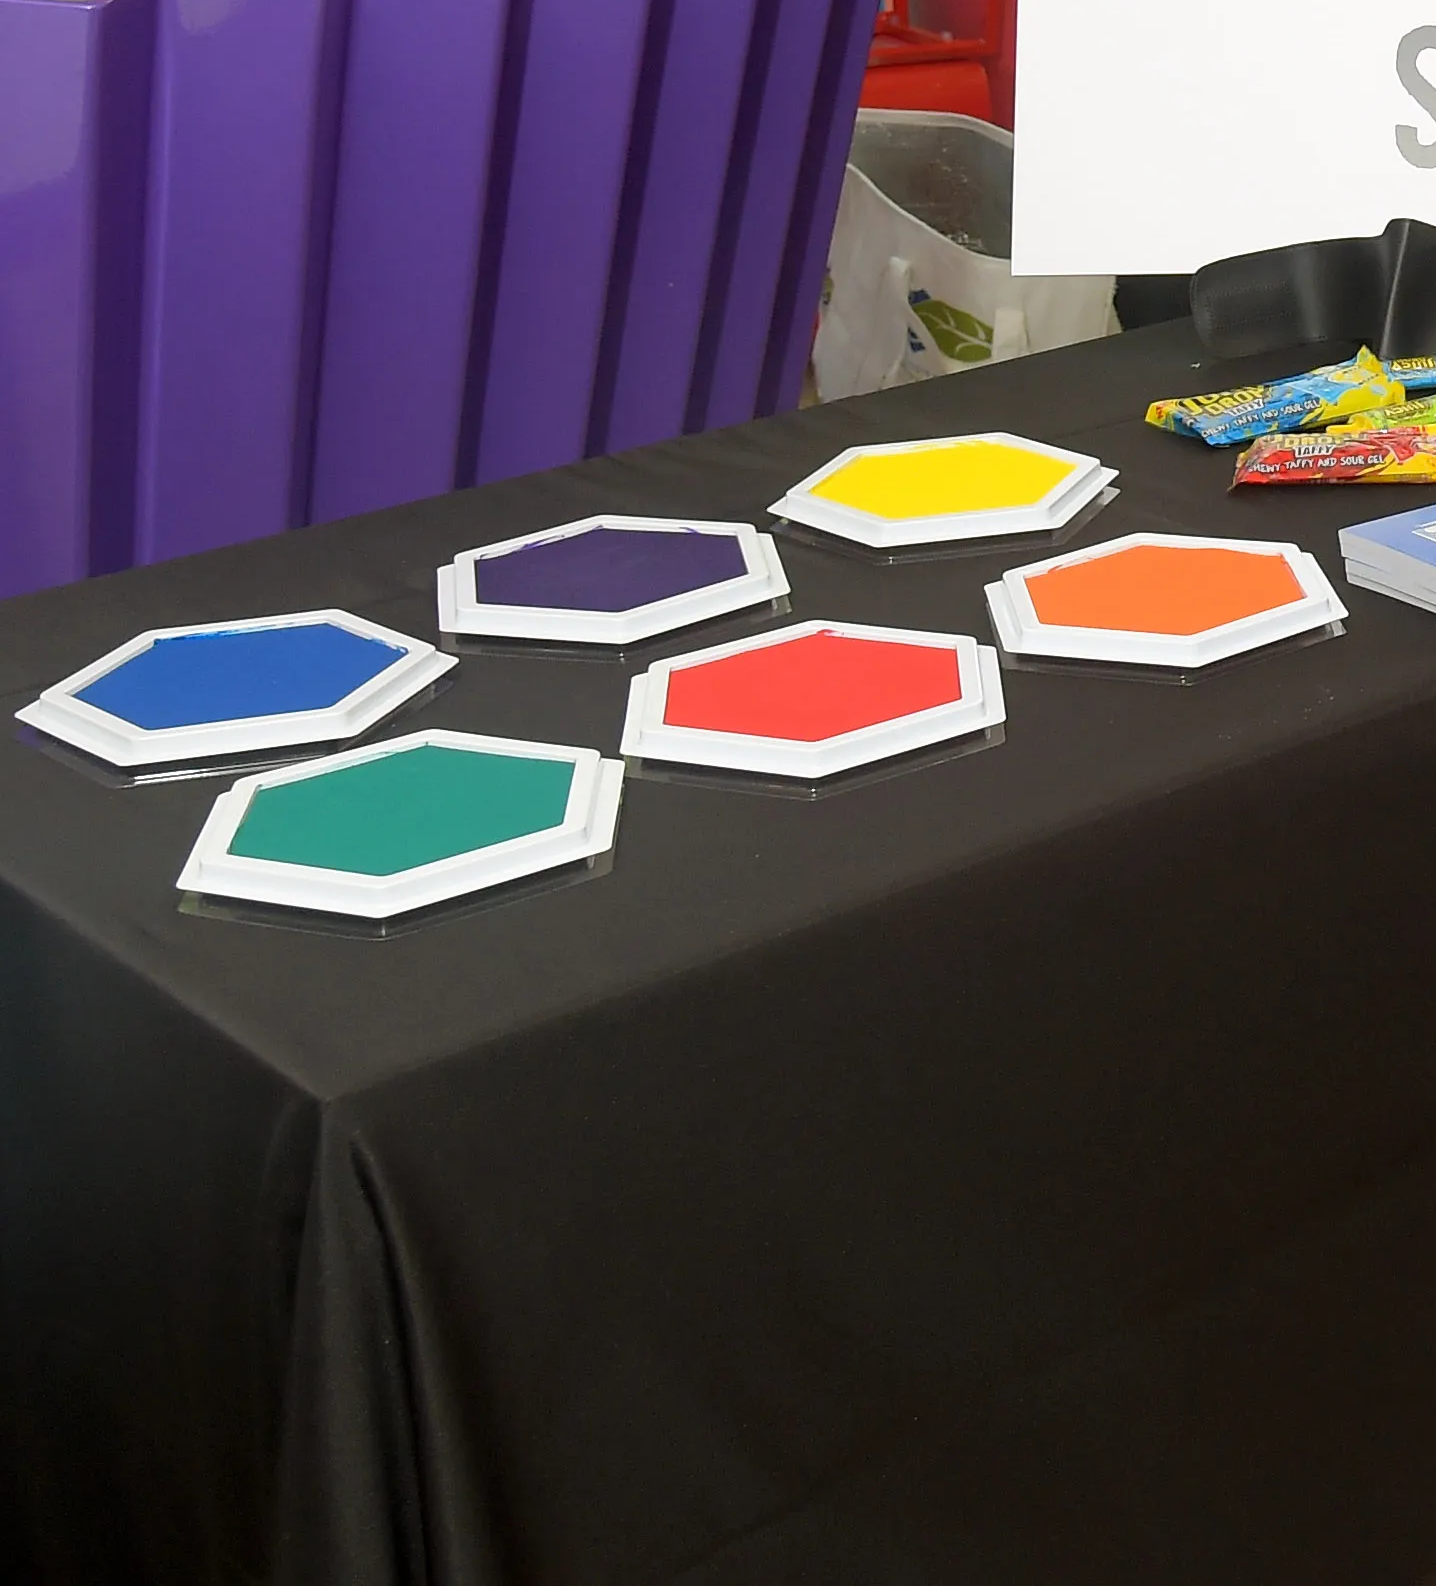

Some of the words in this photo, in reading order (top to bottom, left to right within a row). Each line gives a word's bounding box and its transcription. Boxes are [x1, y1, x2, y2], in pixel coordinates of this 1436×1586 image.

[1304, 399, 1322, 409] GEL
[1284, 459, 1315, 470] TAFFY
[1318, 457, 1337, 467] AND
[1340, 456, 1365, 466] SOUR
[1367, 454, 1385, 464] GEL
